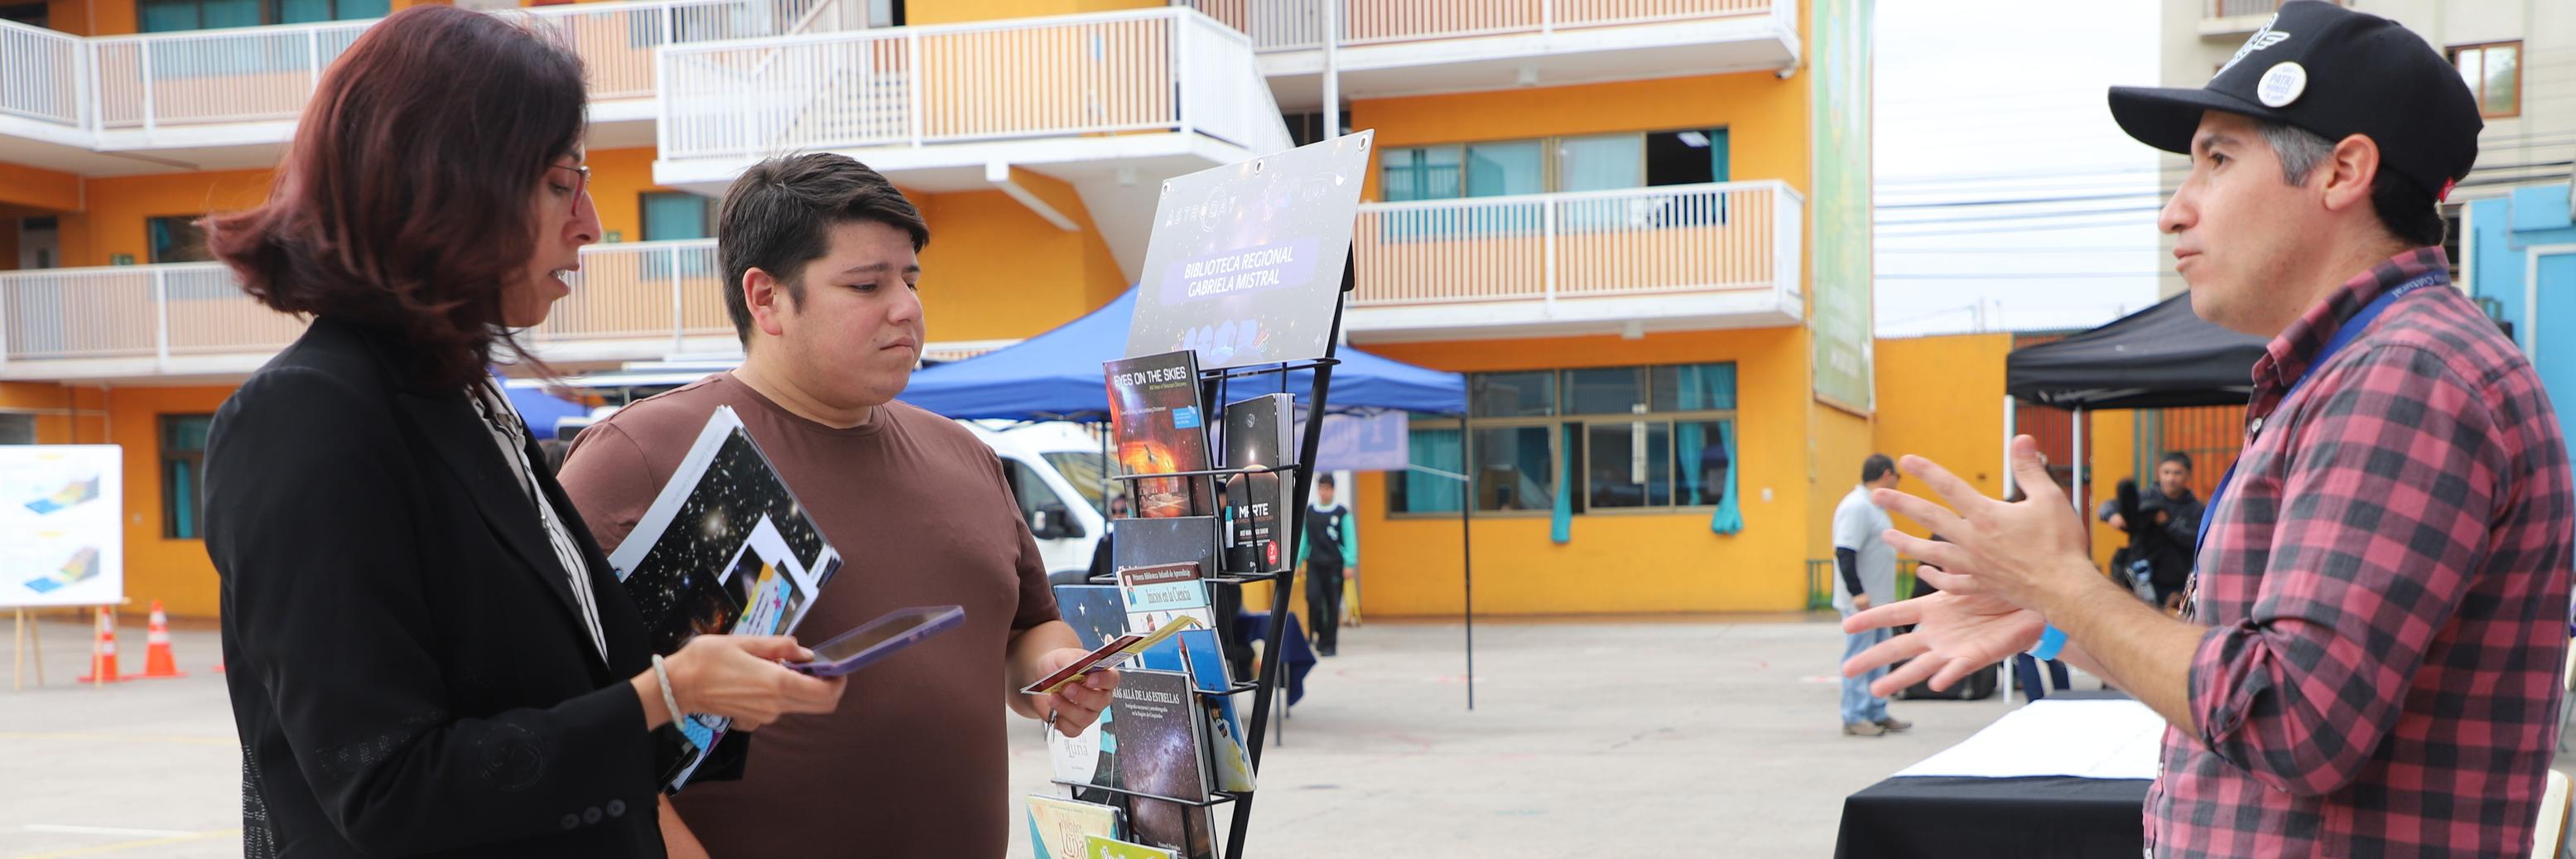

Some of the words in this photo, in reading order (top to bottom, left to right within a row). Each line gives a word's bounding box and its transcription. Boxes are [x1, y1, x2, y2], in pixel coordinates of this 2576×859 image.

[1185, 255, 1242, 279] BIBLIOTECA
[1242, 246, 1293, 270] REGIONAL
[1188, 276, 1234, 297] GABRIELA
[1235, 268, 1279, 291] MISTRAL
[2391, 276, 2434, 297] Cultural
[1114, 373, 1134, 388] EYES
[1134, 372, 1147, 385] ON
[1147, 369, 1163, 383] THE
[1163, 366, 1187, 381] SKIES
[1146, 589, 1163, 604] Inicios
[1163, 592, 1168, 603] en
[1167, 586, 1174, 602] la
[1172, 586, 1192, 601] Ciencia
[1123, 688, 1135, 700] ALLÁ
[1135, 689, 1143, 701] DE
[1143, 690, 1152, 702] LAS
[1153, 692, 1180, 704] ESTRELLAS
